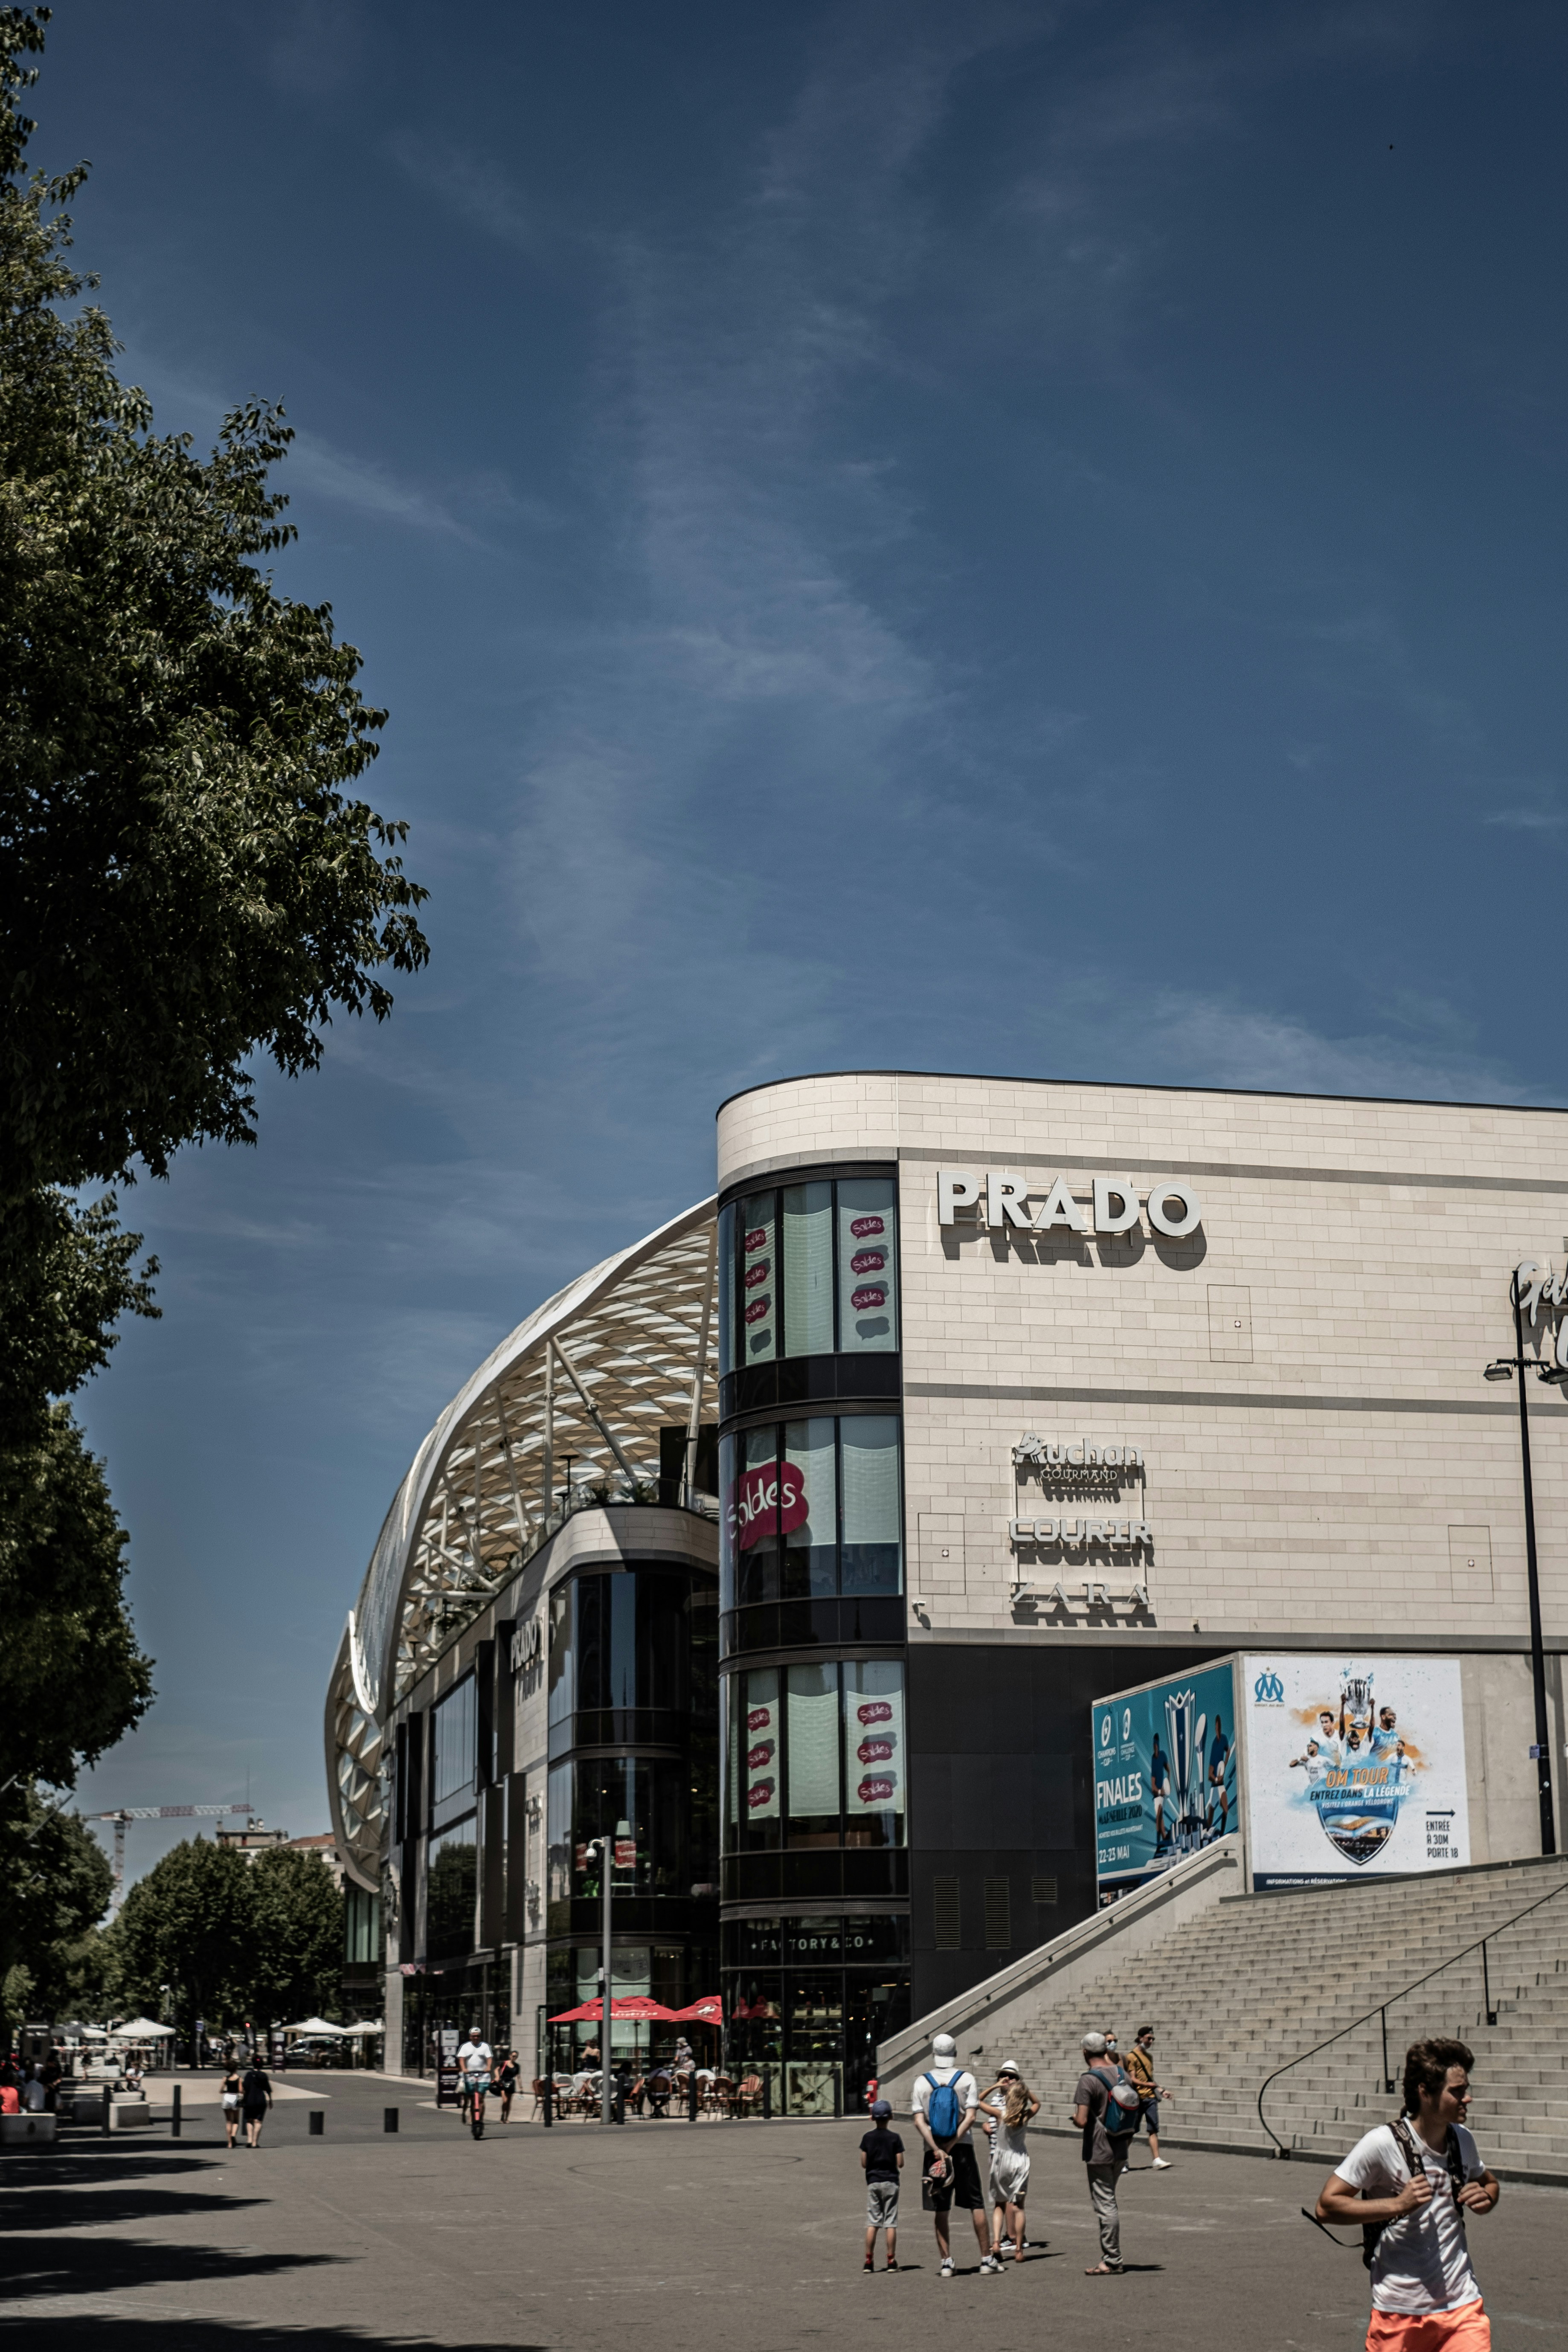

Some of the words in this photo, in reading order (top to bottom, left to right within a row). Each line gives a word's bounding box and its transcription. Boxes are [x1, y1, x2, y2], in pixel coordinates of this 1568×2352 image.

[937, 1170, 1202, 1237] PRADO
[853, 1219, 882, 1234] Soldes
[853, 1255, 882, 1271] Soldes
[854, 1291, 882, 1306] Soldes
[1510, 1258, 1568, 1327] Ga
[1013, 1432, 1144, 1466] Auchan
[1041, 1469, 1118, 1481] GOURMAND
[1009, 1517, 1152, 1544] COURIR
[1010, 1581, 1154, 1605] ZARA
[510, 1614, 538, 1673] PRADO
[860, 1705, 890, 1721] Soldes
[860, 1744, 890, 1760] Soldes
[1326, 1769, 1348, 1788] OM
[1353, 1767, 1389, 1786] TOUR
[860, 1783, 890, 1798] Soldes
[1097, 1772, 1142, 1809] FINALES
[1310, 1789, 1339, 1801] ENTREZ
[1341, 1788, 1363, 1799] DANS
[1364, 1787, 1373, 1798] LA
[1375, 1784, 1411, 1797] LÉGENDE
[1426, 1819, 1450, 1831] ENTRÉE
[1433, 1834, 1449, 1844] 30M
[1099, 1847, 1116, 1863] 22-23
[1117, 1844, 1130, 1860] MAI
[1427, 1847, 1449, 1858] PORTE
[1451, 1847, 1458, 1858] 18
